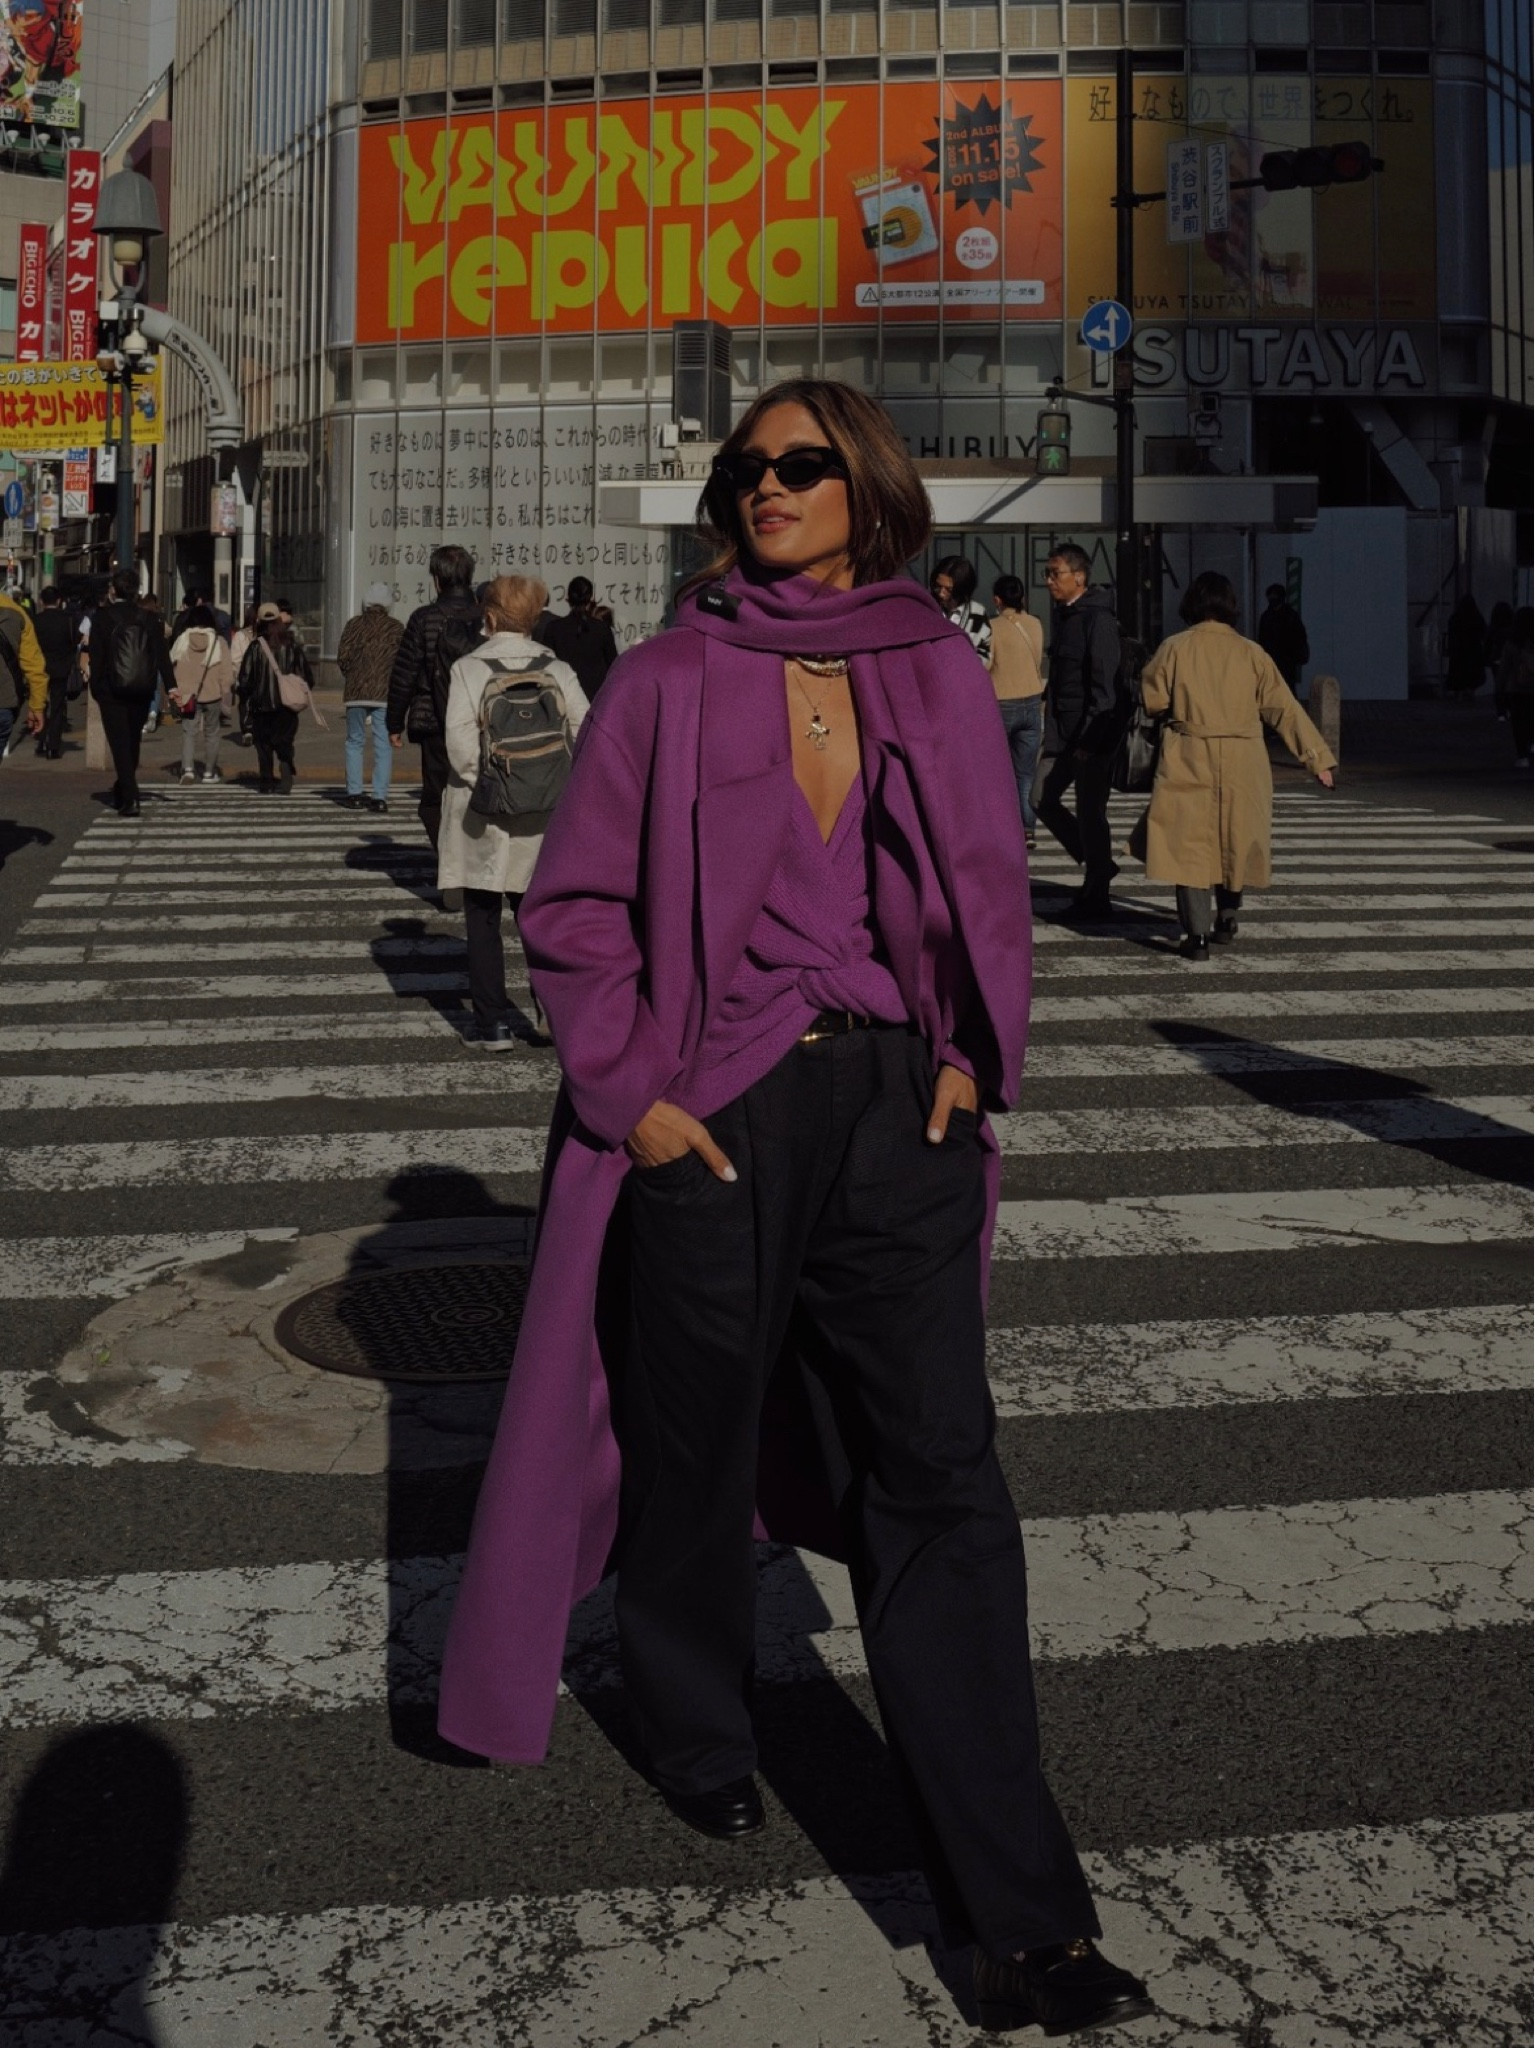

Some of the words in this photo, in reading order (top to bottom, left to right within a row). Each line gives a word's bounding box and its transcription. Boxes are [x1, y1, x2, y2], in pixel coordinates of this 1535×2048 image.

[1089, 86, 1415, 119] 好なもので、世界をつくれ。
[971, 123, 1014, 137] ALBUM
[387, 99, 849, 225] VAUNDY
[959, 136, 1020, 166] 11.15
[951, 172, 974, 187] on
[1182, 146, 1199, 233] 渋谷駅前
[66, 167, 97, 294] カラオケ
[387, 217, 839, 329] replica
[1087, 295, 1169, 309] SUYA
[1178, 295, 1258, 309] TSUTAY
[1077, 327, 1425, 388] TSUTAYA
[903, 436, 1036, 458] HIBUY
[368, 503, 602, 529] しの海に置き去りにする。私たちはこれ
[368, 541, 668, 567] りあげる必る。好きなものをもつと同じもの
